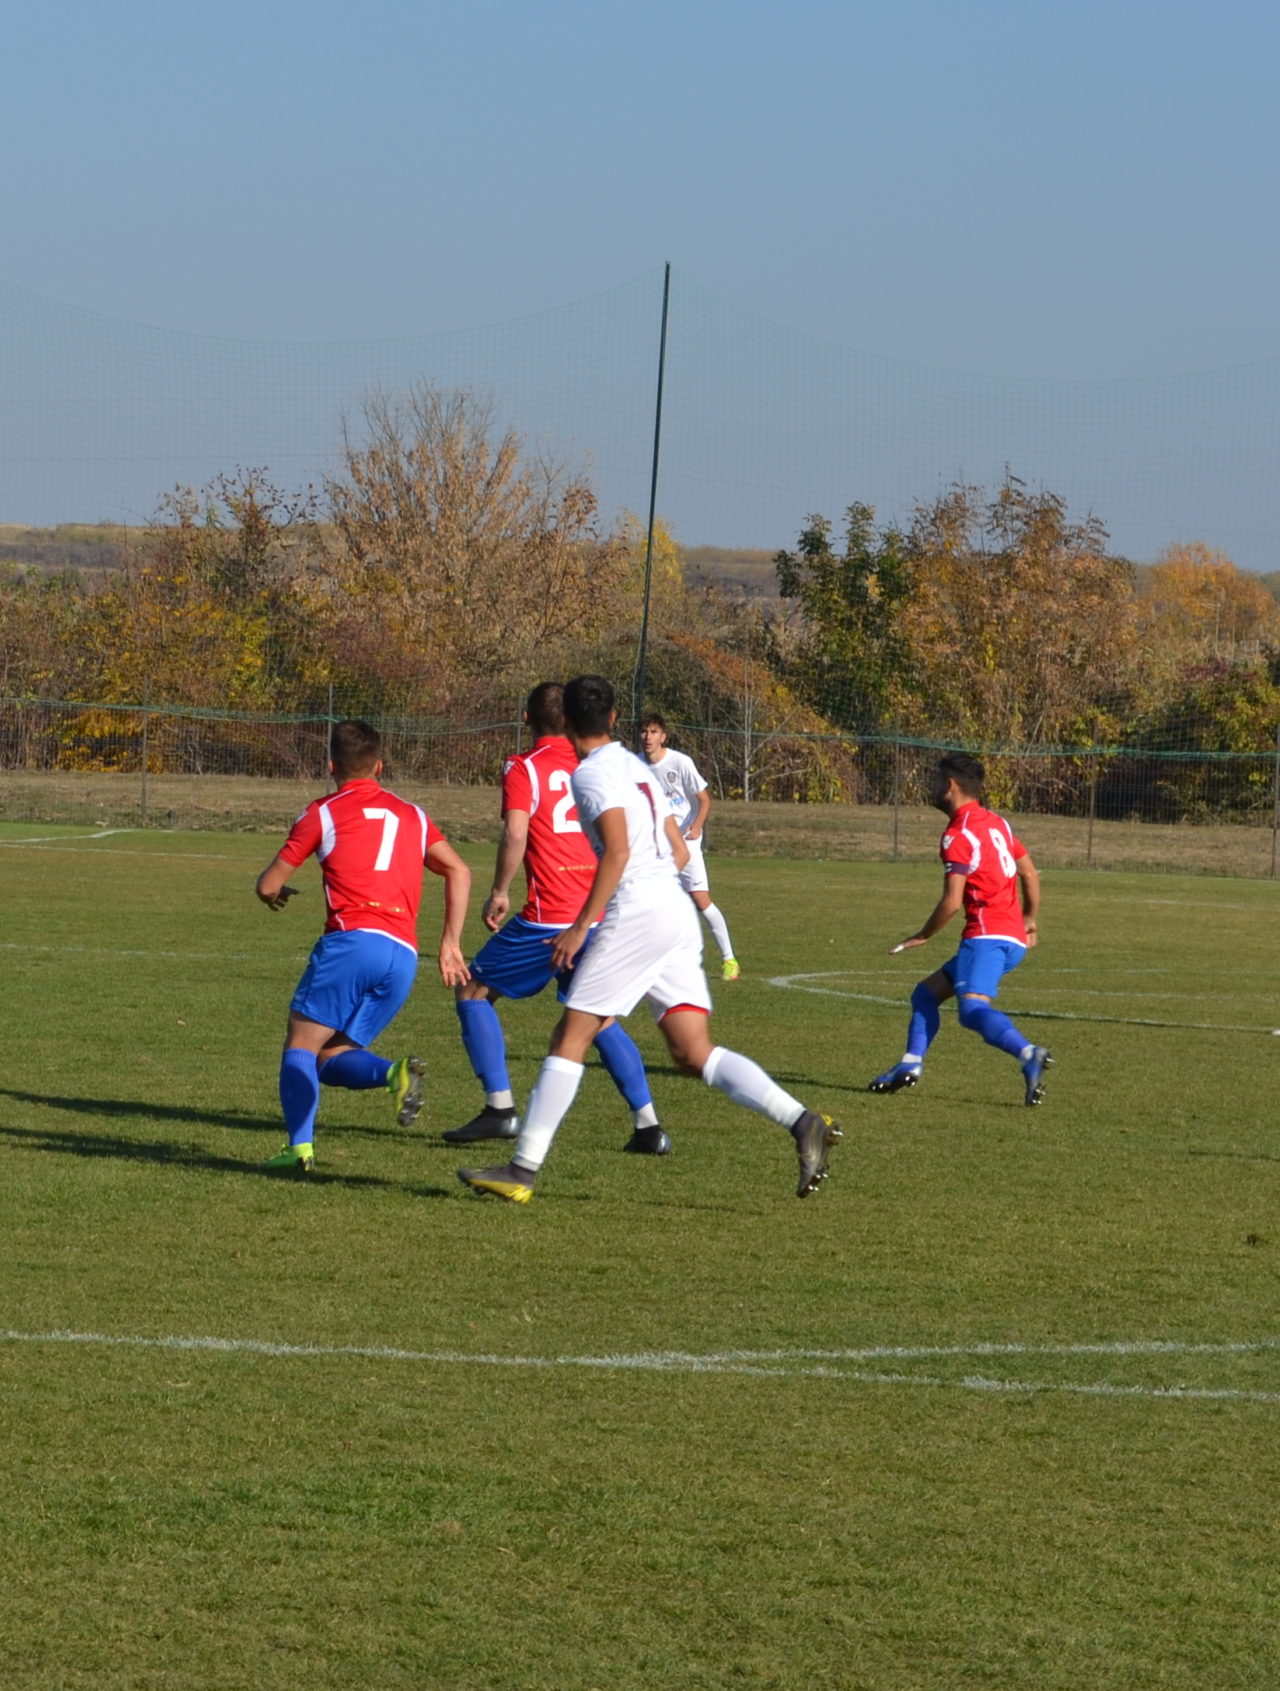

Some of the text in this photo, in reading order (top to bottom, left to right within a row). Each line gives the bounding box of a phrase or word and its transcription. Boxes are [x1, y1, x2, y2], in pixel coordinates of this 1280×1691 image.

[549, 769, 582, 834] 2
[362, 808, 400, 871] 7
[988, 828, 1017, 878] 8
